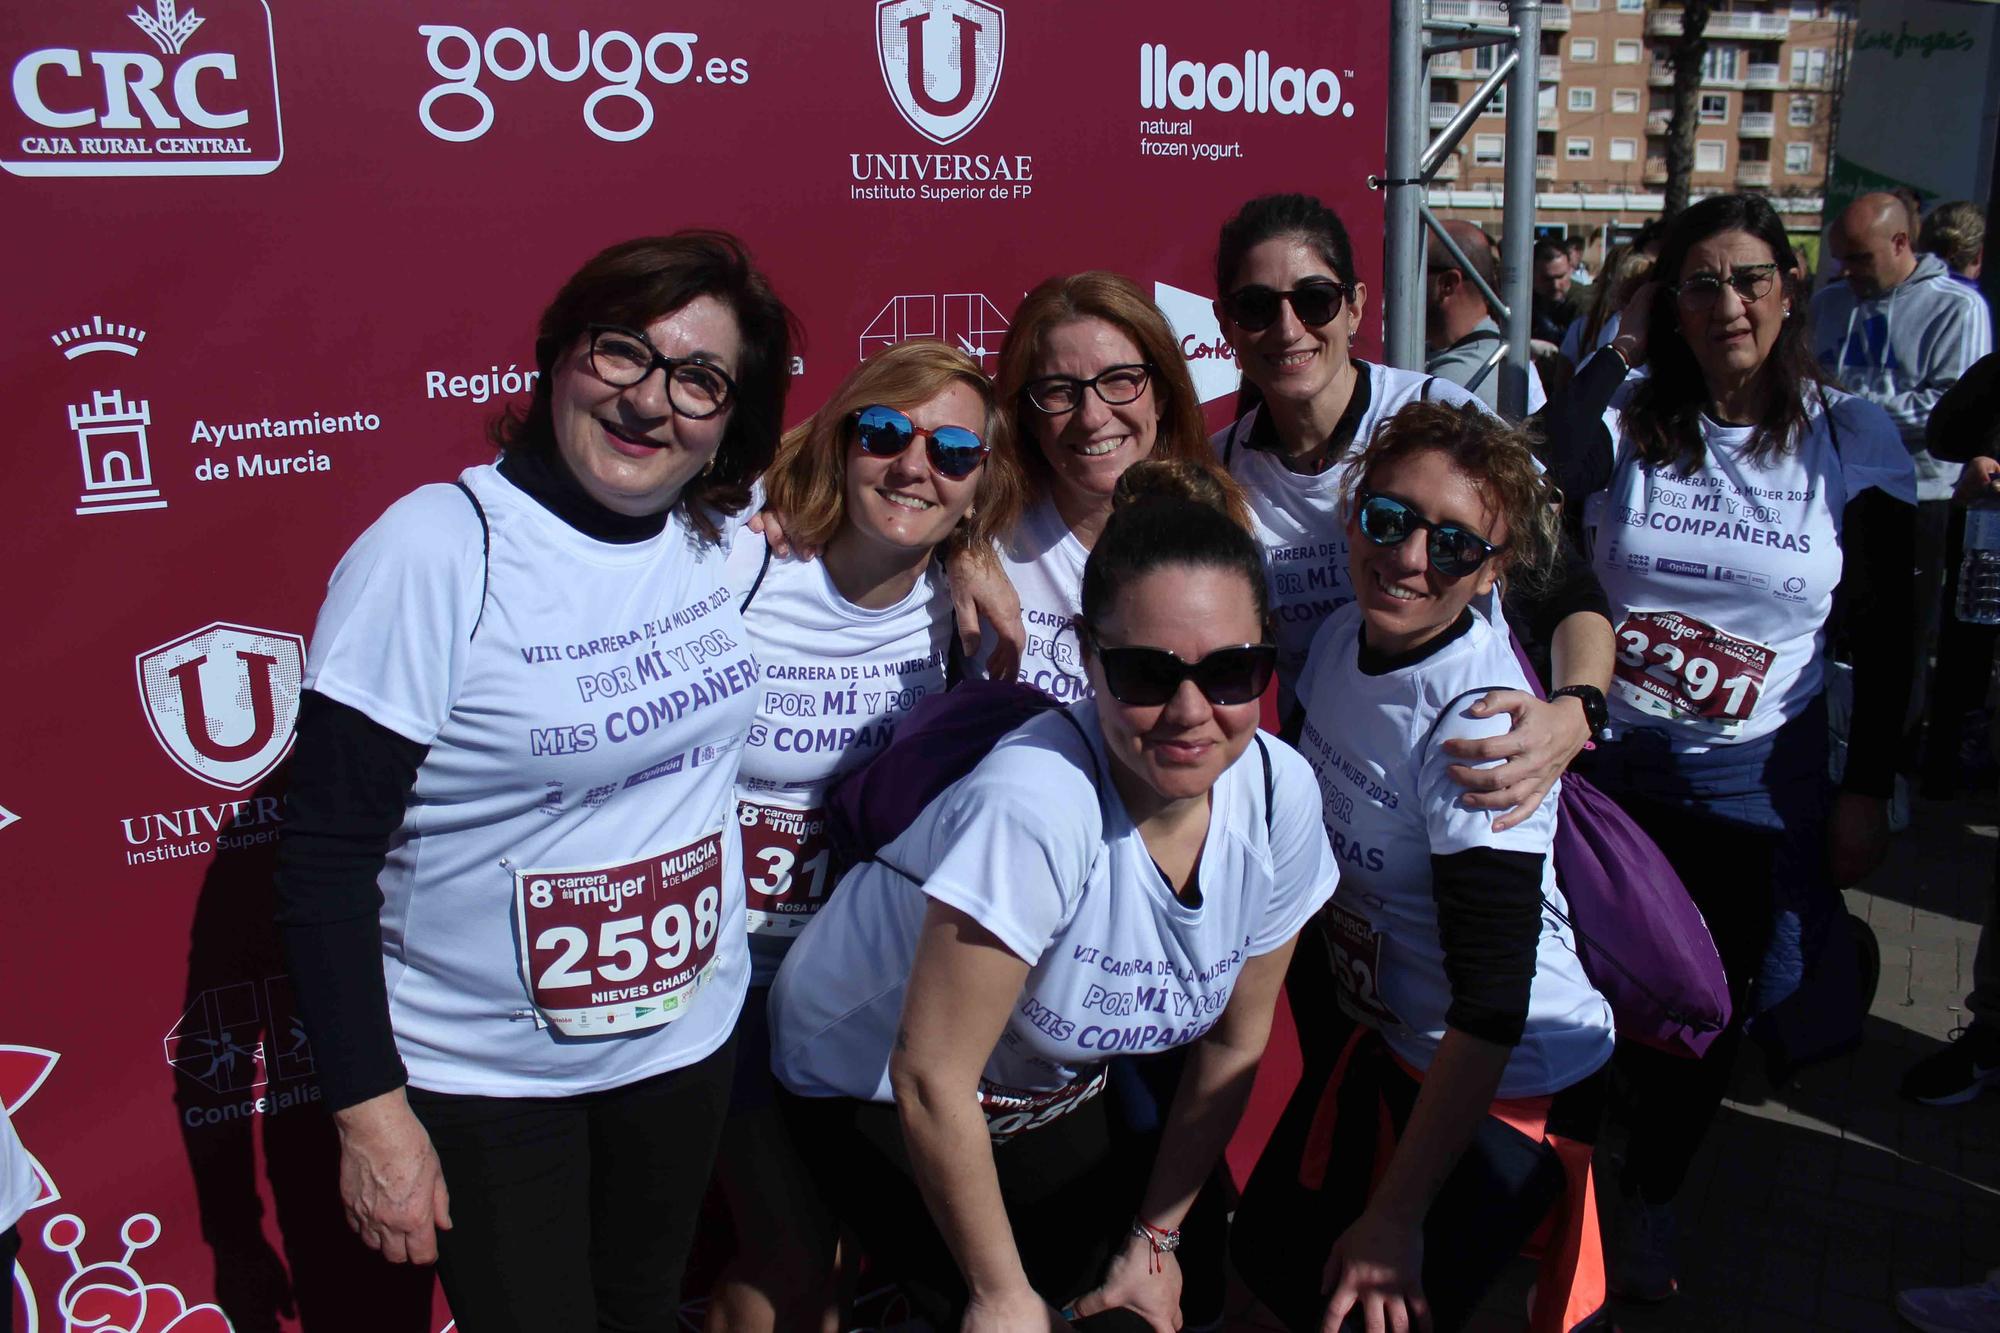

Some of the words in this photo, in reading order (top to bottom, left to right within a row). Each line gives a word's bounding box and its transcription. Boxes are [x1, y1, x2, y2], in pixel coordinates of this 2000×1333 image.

[13, 48, 248, 129] CRC
[1140, 118, 1192, 135] natural
[22, 137, 77, 154] CAJA
[80, 138, 152, 154] RURAL
[155, 138, 251, 154] CENTRAL
[1141, 138, 1188, 155] frozen
[1192, 141, 1243, 160] yogurt.
[850, 153, 1033, 181] UNIVERSAE
[851, 185, 915, 199] Instituto
[921, 185, 985, 202] Superior
[989, 185, 1008, 199] de
[1013, 185, 1032, 199] FP
[190, 411, 381, 447] Ayuntamiento
[195, 457, 230, 481] de
[236, 449, 331, 478] Murcia
[1654, 468, 1706, 487] CARRERA
[1710, 477, 1726, 488] DE
[1744, 486, 1783, 500] MUJER
[1649, 486, 1686, 509] POR
[1691, 488, 1723, 512] MÍ
[1725, 498, 1739, 514] Y
[1743, 506, 1782, 524] POR
[1649, 511, 1812, 554] COMPAÑERAS
[521, 646, 562, 664] VIII
[566, 630, 642, 660] CARRERA
[643, 621, 656, 640] DE
[658, 616, 673, 634] LA
[673, 600, 711, 628] MUJER
[708, 586, 731, 609] 2023
[1655, 617, 1703, 640] mujer
[577, 665, 636, 702] POR
[635, 641, 672, 685] MÍ
[667, 647, 689, 671] Y
[686, 629, 738, 664] POR
[1027, 634, 1073, 666] POR
[1724, 648, 1748, 664] MARZO
[1747, 658, 1764, 671] 2023
[766, 665, 836, 680] CARRERA
[840, 667, 859, 680] DE
[863, 664, 881, 679] LA
[884, 658, 925, 676] MUJER
[1616, 630, 1753, 717] 3291
[765, 691, 817, 716] POR
[822, 682, 858, 715] MÍ
[864, 692, 880, 715] Y
[530, 723, 597, 756] MIS
[1331, 751, 1343, 769] LA
[1341, 760, 1367, 790] MUJER
[1366, 782, 1399, 809] 2023
[121, 795, 288, 845] UNIVER
[764, 808, 804, 822] carrera
[1326, 785, 1353, 824] POR
[127, 841, 211, 865] Instituto
[661, 840, 717, 878] MURCIA
[557, 874, 608, 888] carrera
[662, 879, 668, 889] 5
[669, 876, 681, 887] DE
[682, 864, 704, 882] MARZO
[704, 856, 718, 873] 2023
[574, 875, 646, 912] mujer
[776, 902, 807, 913] ROSA
[535, 886, 719, 990] 2598
[591, 985, 649, 1004] NIEVES
[653, 964, 698, 993] CHARLY
[1158, 960, 1173, 975] DE
[1178, 968, 1194, 983] LA
[1083, 984, 1133, 1016] POR
[1134, 978, 1169, 1014] MÍ
[1173, 991, 1194, 1016] Y
[1022, 998, 1076, 1041] MIS
[1077, 1016, 1220, 1050] COMPAÑE
[185, 1083, 321, 1127] Concejalía
